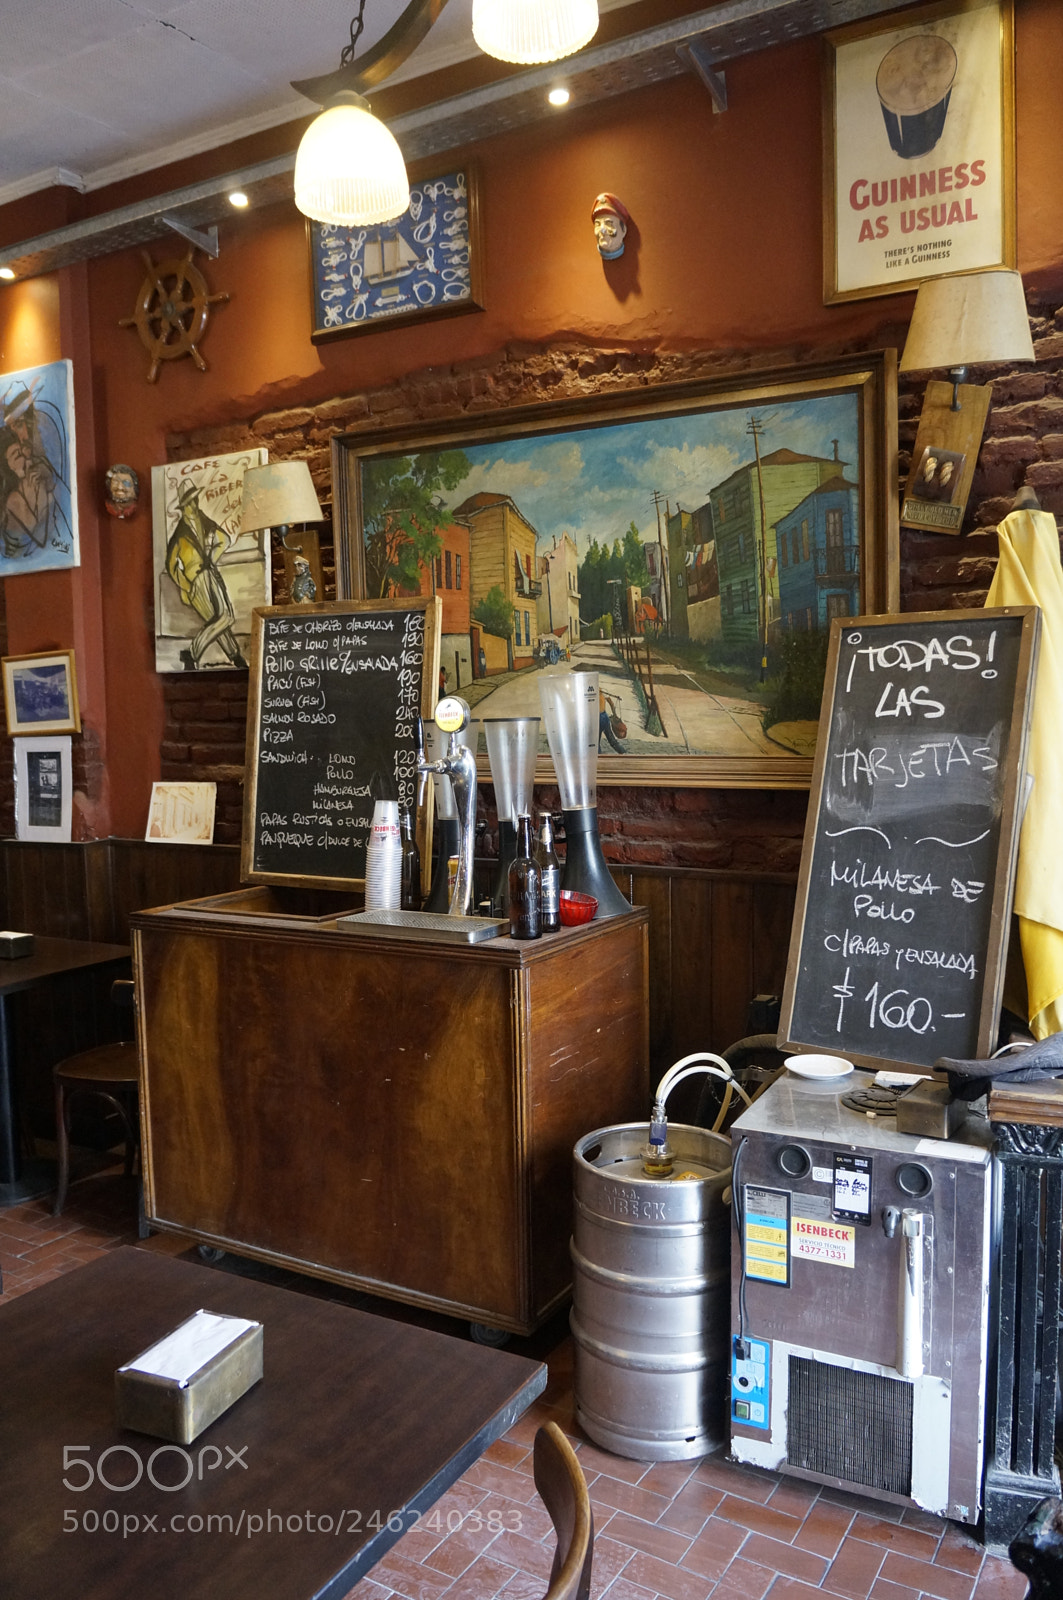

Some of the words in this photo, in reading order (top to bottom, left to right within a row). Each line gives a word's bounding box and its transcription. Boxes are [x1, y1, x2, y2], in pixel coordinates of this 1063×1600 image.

[849, 160, 986, 211] GUINNESS
[857, 215, 889, 243] AS
[900, 198, 978, 234] USUAL
[884, 246, 914, 259] THERE'S
[917, 239, 952, 253] NOTHING
[886, 259, 902, 269] LIKE
[904, 257, 910, 266] A
[911, 250, 951, 264] GUINNESS
[180, 460, 220, 476] CAFE
[268, 620, 290, 636] BIFE
[292, 623, 304, 634] DE
[268, 639, 289, 654] BIFE
[291, 640, 303, 651] DE
[305, 638, 329, 651] LOMO
[401, 632, 424, 648] 190
[399, 649, 424, 667] 160
[397, 668, 421, 688] 190
[397, 685, 419, 706] 170
[875, 681, 946, 719] LAS
[297, 711, 337, 724] ROSADO
[263, 727, 294, 744] PIZZA
[329, 753, 357, 766] LOMO
[393, 749, 416, 766] 120
[834, 735, 998, 788] TARJETAS
[393, 765, 415, 782] 100
[397, 780, 415, 796] 80
[260, 812, 288, 827] PAPAS
[260, 830, 314, 849] PANQUEQUE
[353, 837, 363, 848] DE
[950, 877, 986, 903] DE
[904, 948, 979, 980] ENSALADA
[796, 1222, 849, 1241] ISENBECK
[799, 1244, 847, 1261] 4377-1331
